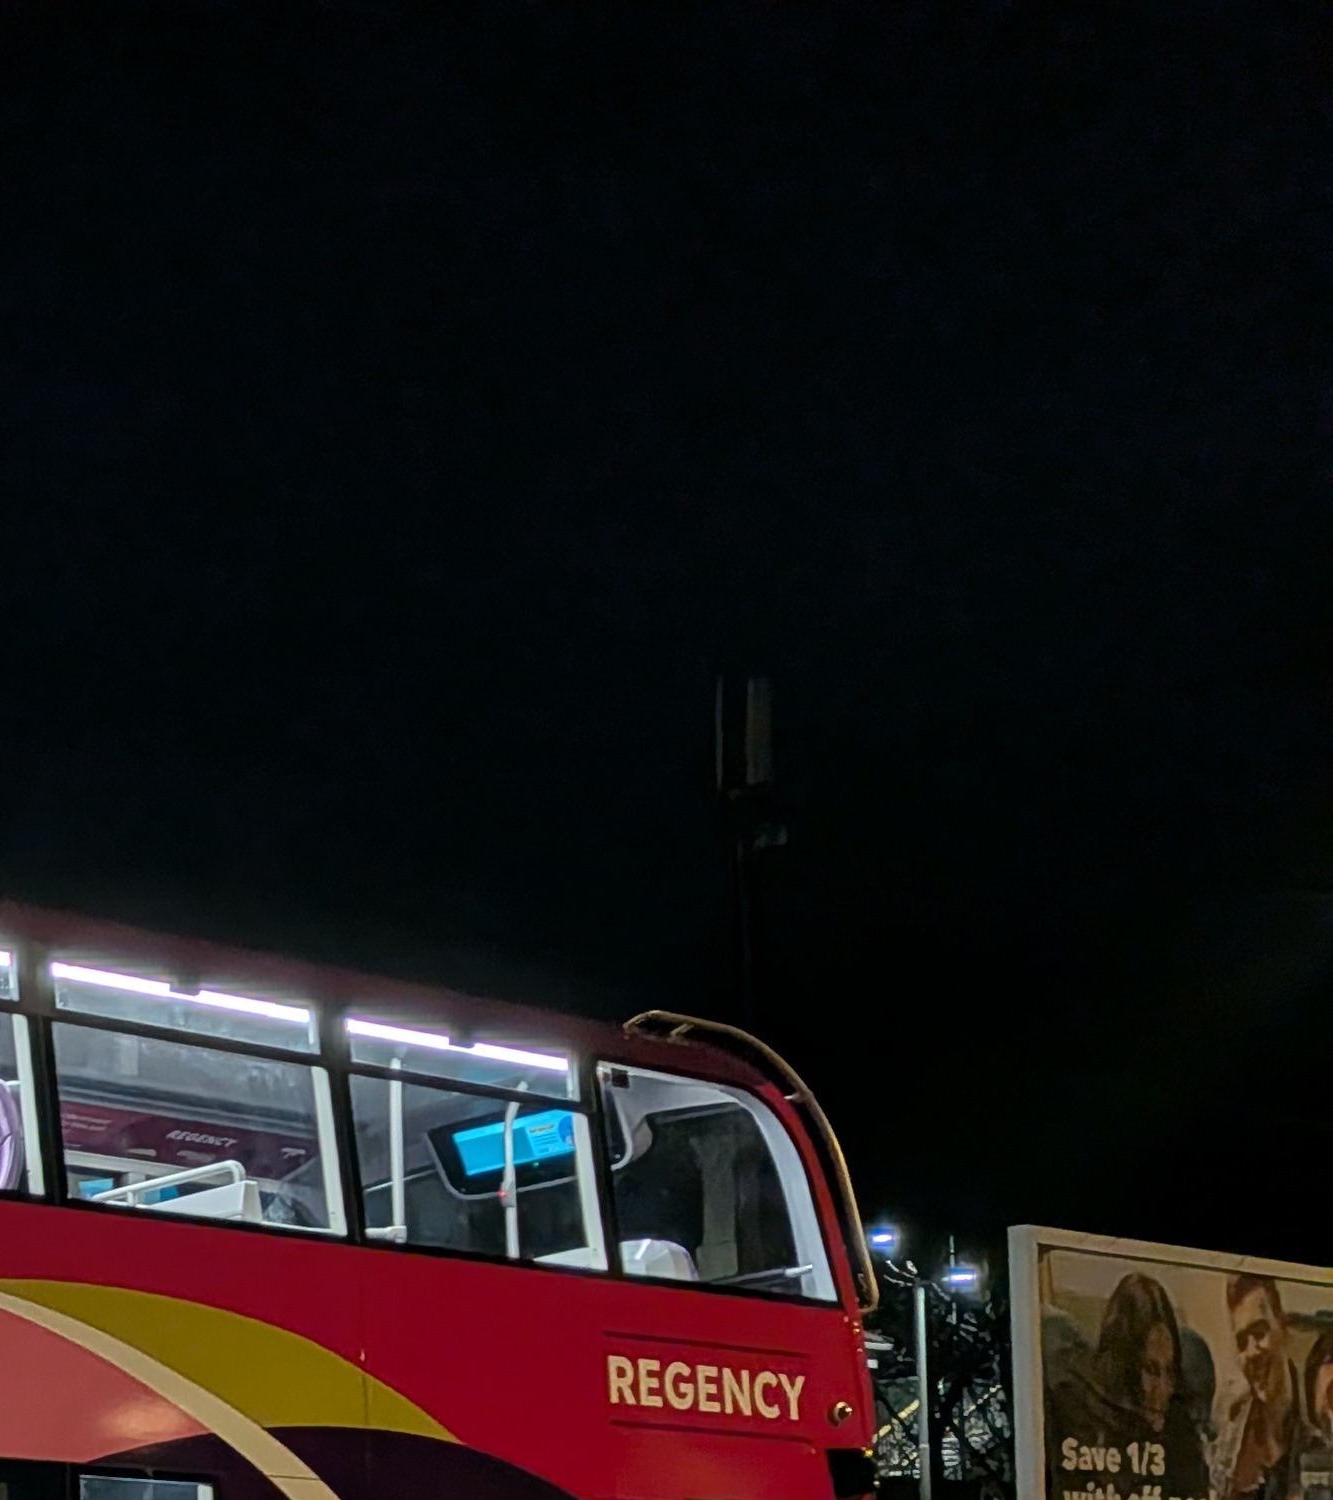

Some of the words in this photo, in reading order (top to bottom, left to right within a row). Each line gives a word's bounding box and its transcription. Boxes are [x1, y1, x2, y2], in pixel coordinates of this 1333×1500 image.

[607, 1354, 806, 1421] REGENCY
[1061, 1437, 1122, 1473] Save
[1126, 1441, 1166, 1476] 1/3
